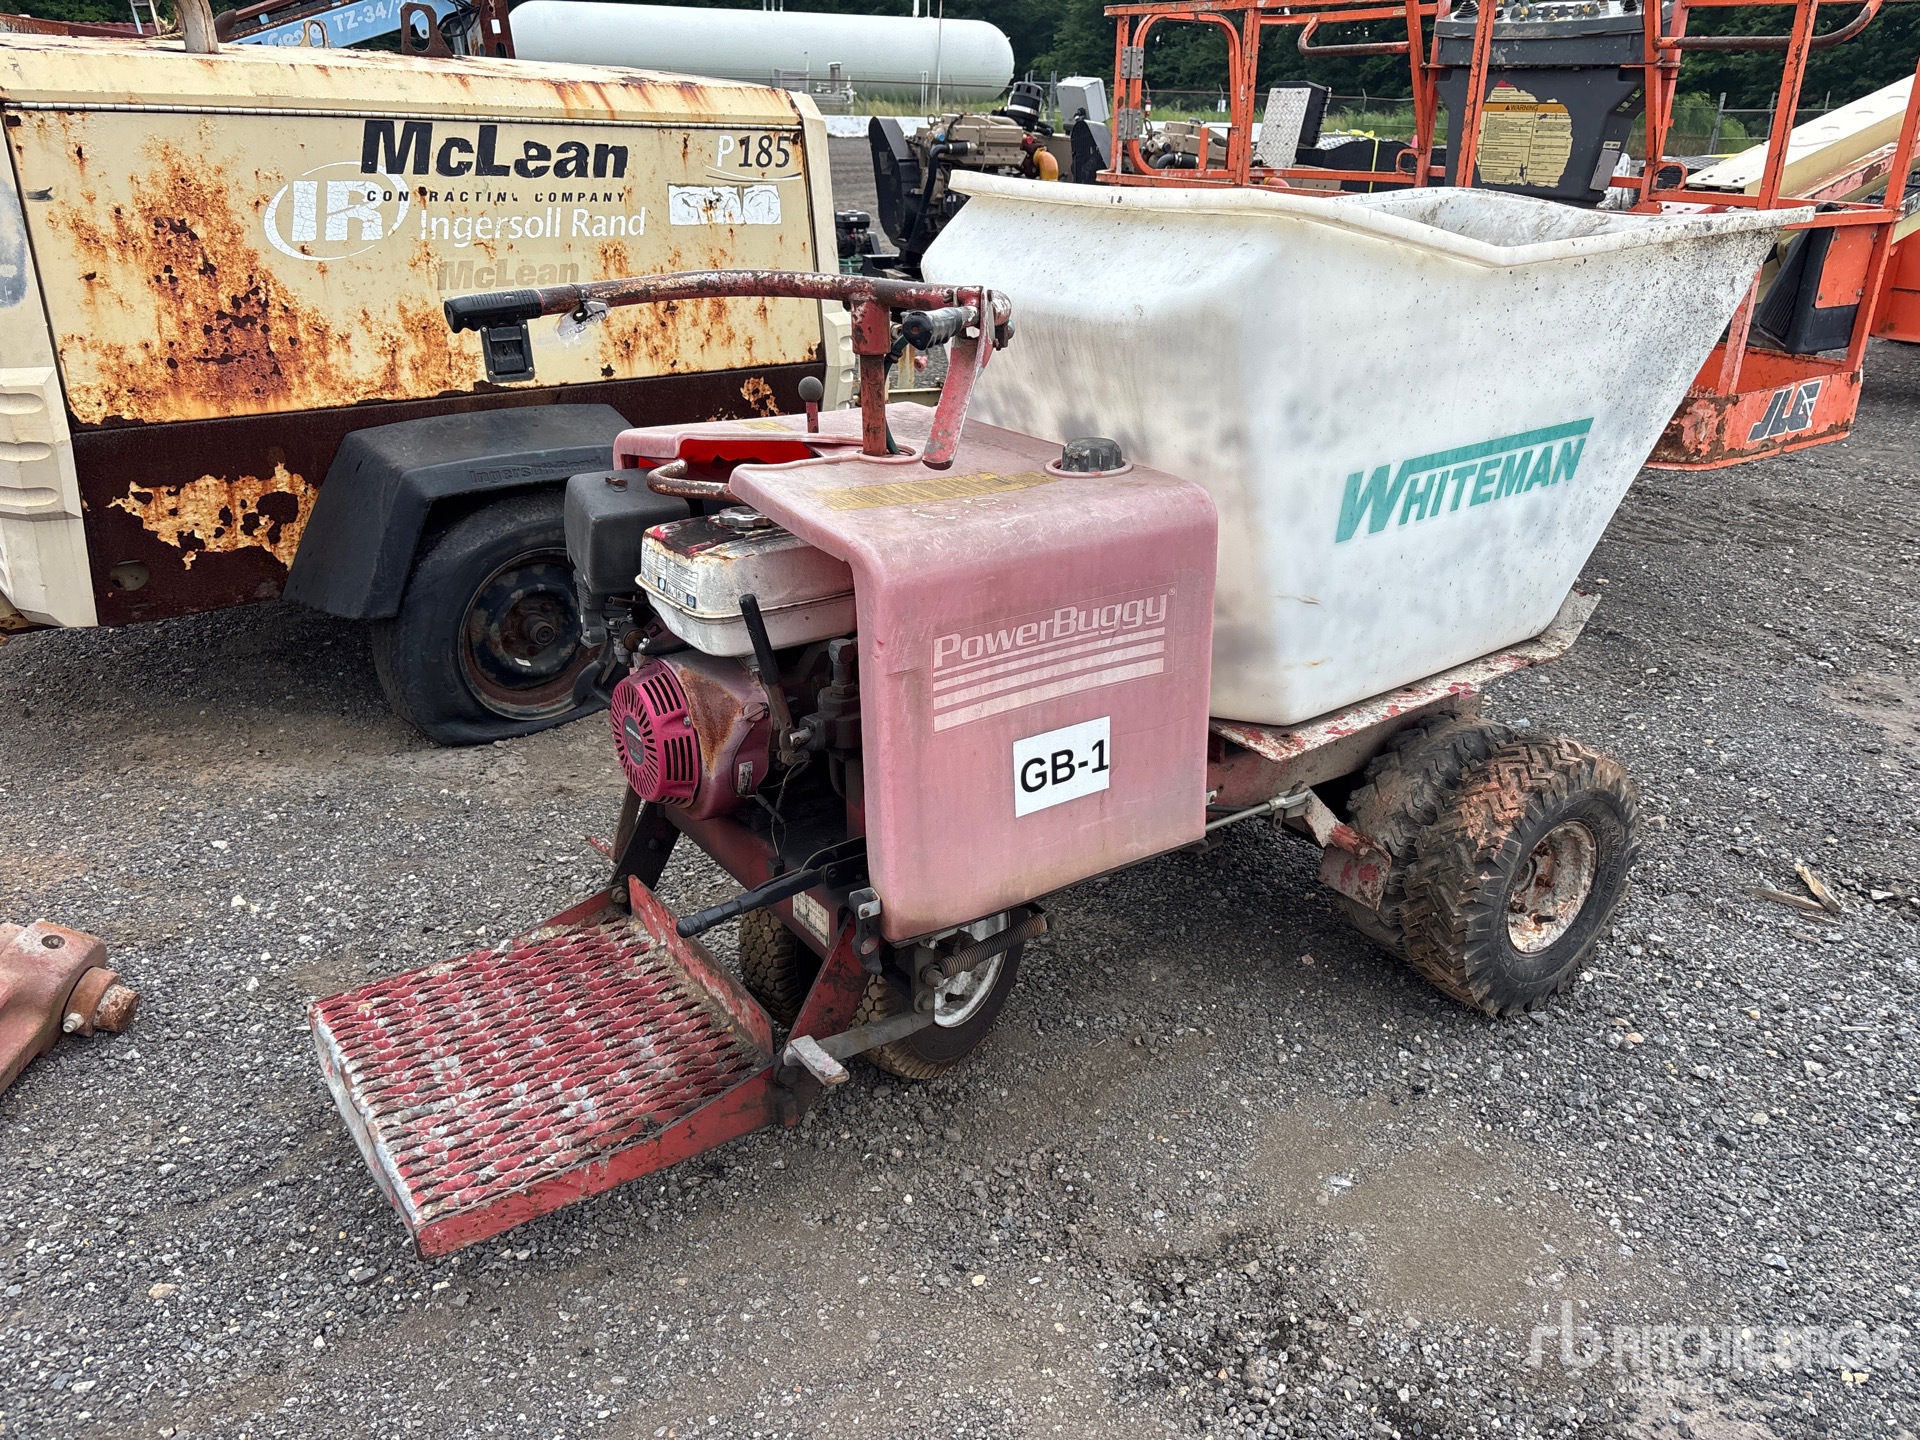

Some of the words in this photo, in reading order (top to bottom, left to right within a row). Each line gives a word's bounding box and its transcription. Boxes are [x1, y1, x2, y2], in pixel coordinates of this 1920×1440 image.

[1511, 104, 1539, 112] WARNING
[361, 120, 629, 179] McLean
[292, 181, 383, 242] IR
[366, 190, 518, 203] CONRACTIN
[534, 192, 625, 203] COMPANY
[420, 206, 561, 249] Ingersoll
[572, 207, 646, 238] Rand
[436, 258, 580, 291] McLean
[1746, 380, 1823, 443] JLG
[1335, 417, 1594, 543] WHITEMAN
[1020, 738, 1109, 793] GB-1
